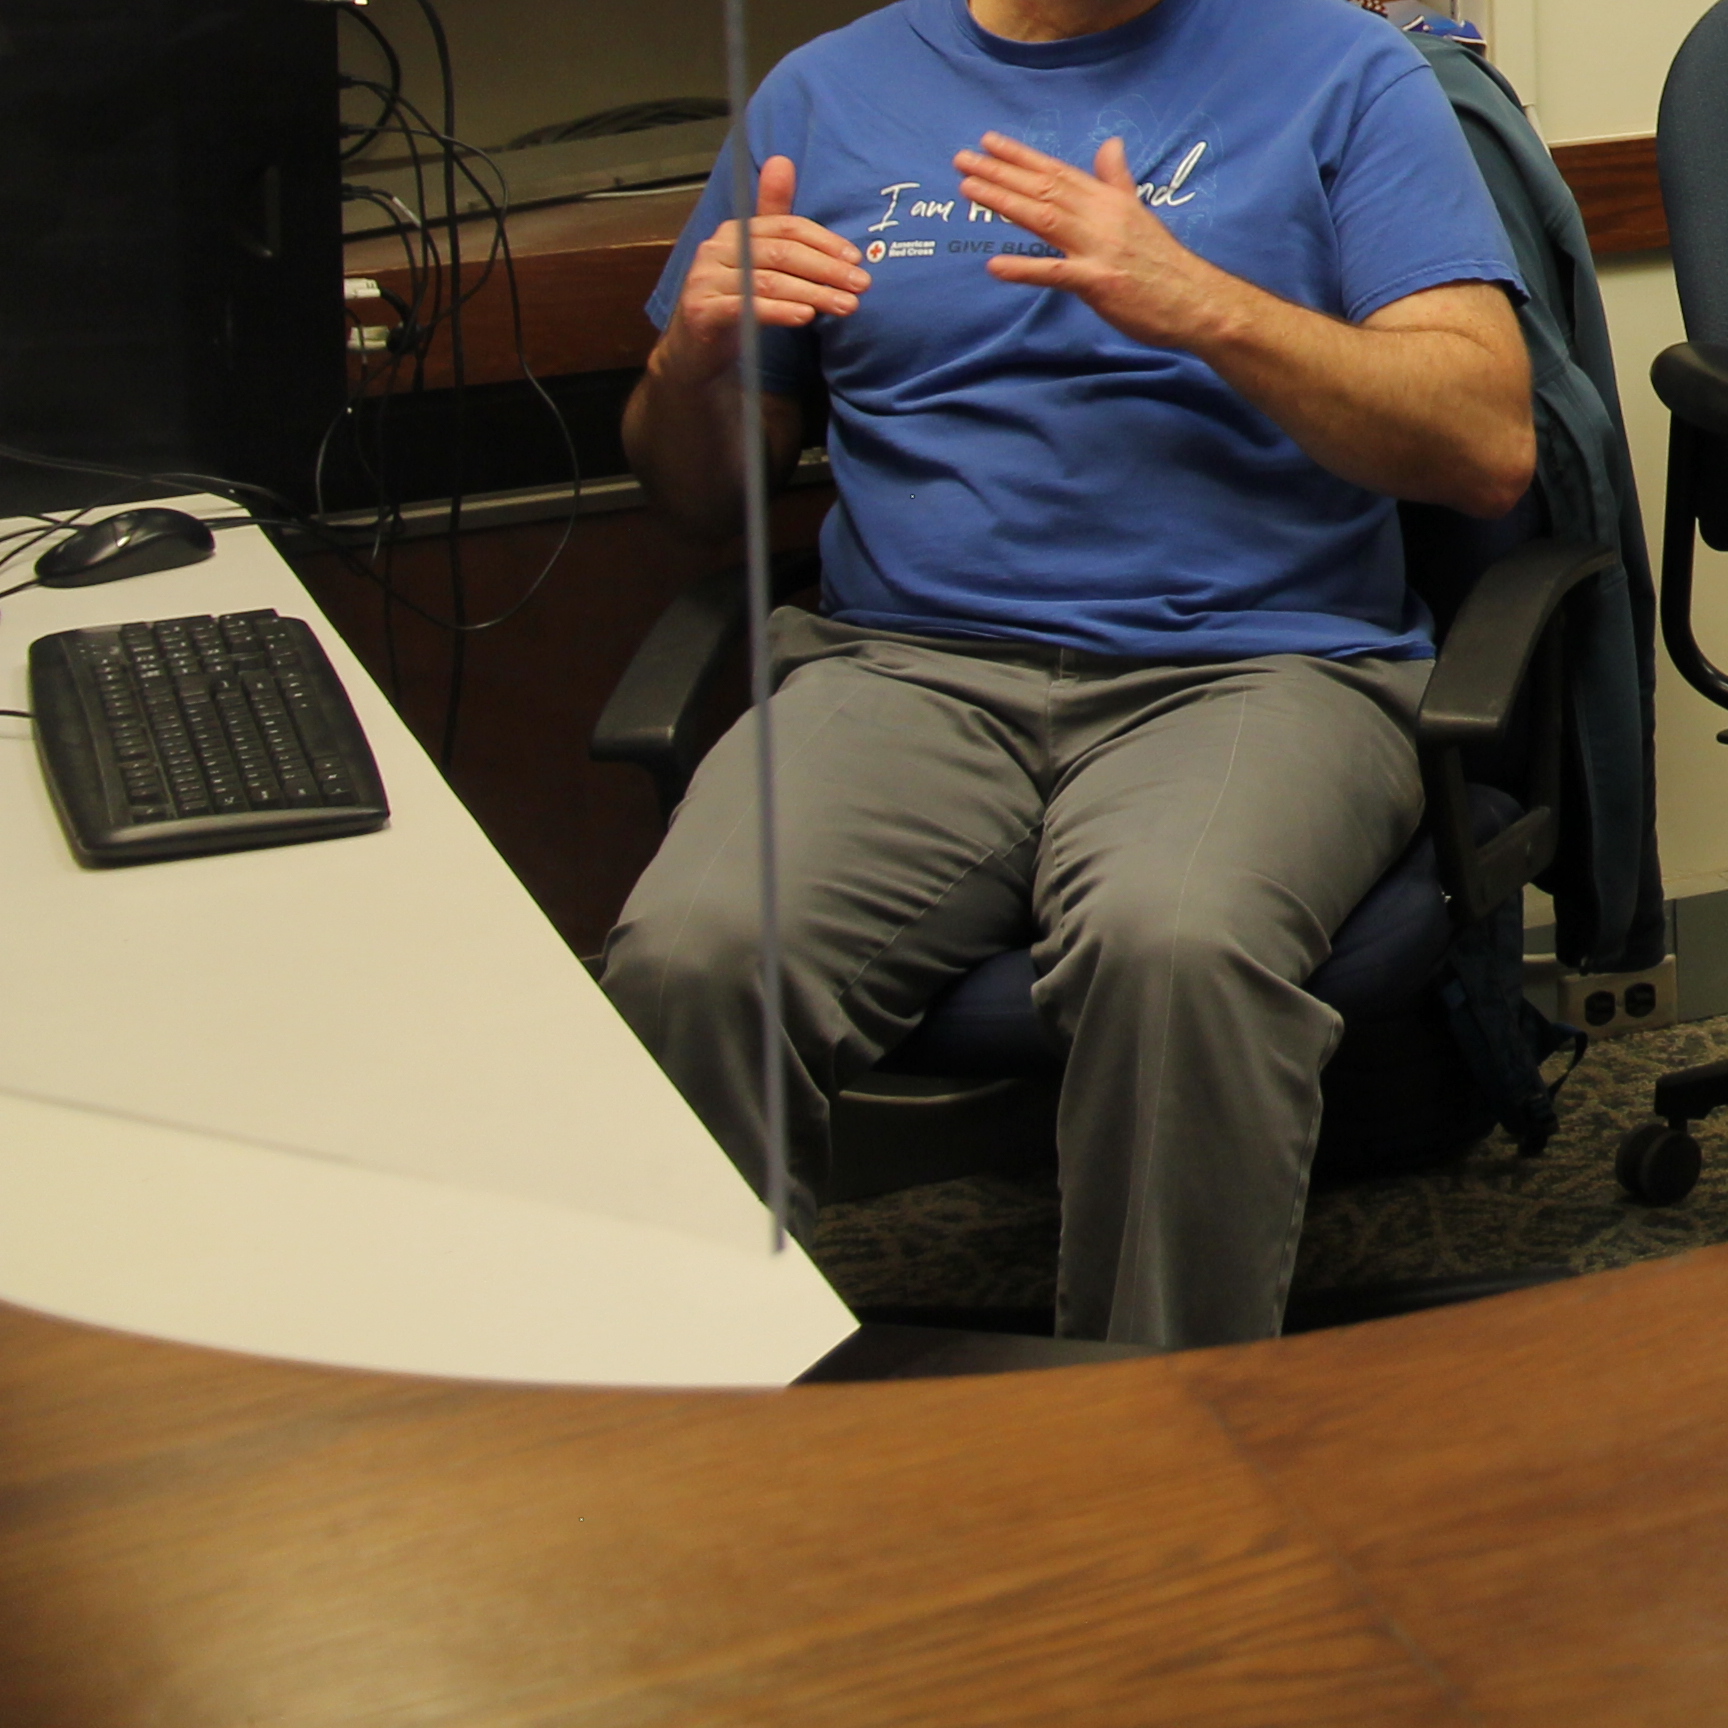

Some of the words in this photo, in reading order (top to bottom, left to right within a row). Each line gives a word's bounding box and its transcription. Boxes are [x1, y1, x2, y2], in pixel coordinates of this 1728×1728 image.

[868, 182, 921, 233] I
[910, 198, 956, 222] am
[1137, 141, 1207, 207] nd
[890, 240, 936, 249] American
[948, 240, 996, 254] GIVE
[889, 249, 907, 257] Red
[907, 248, 934, 257] Cross
